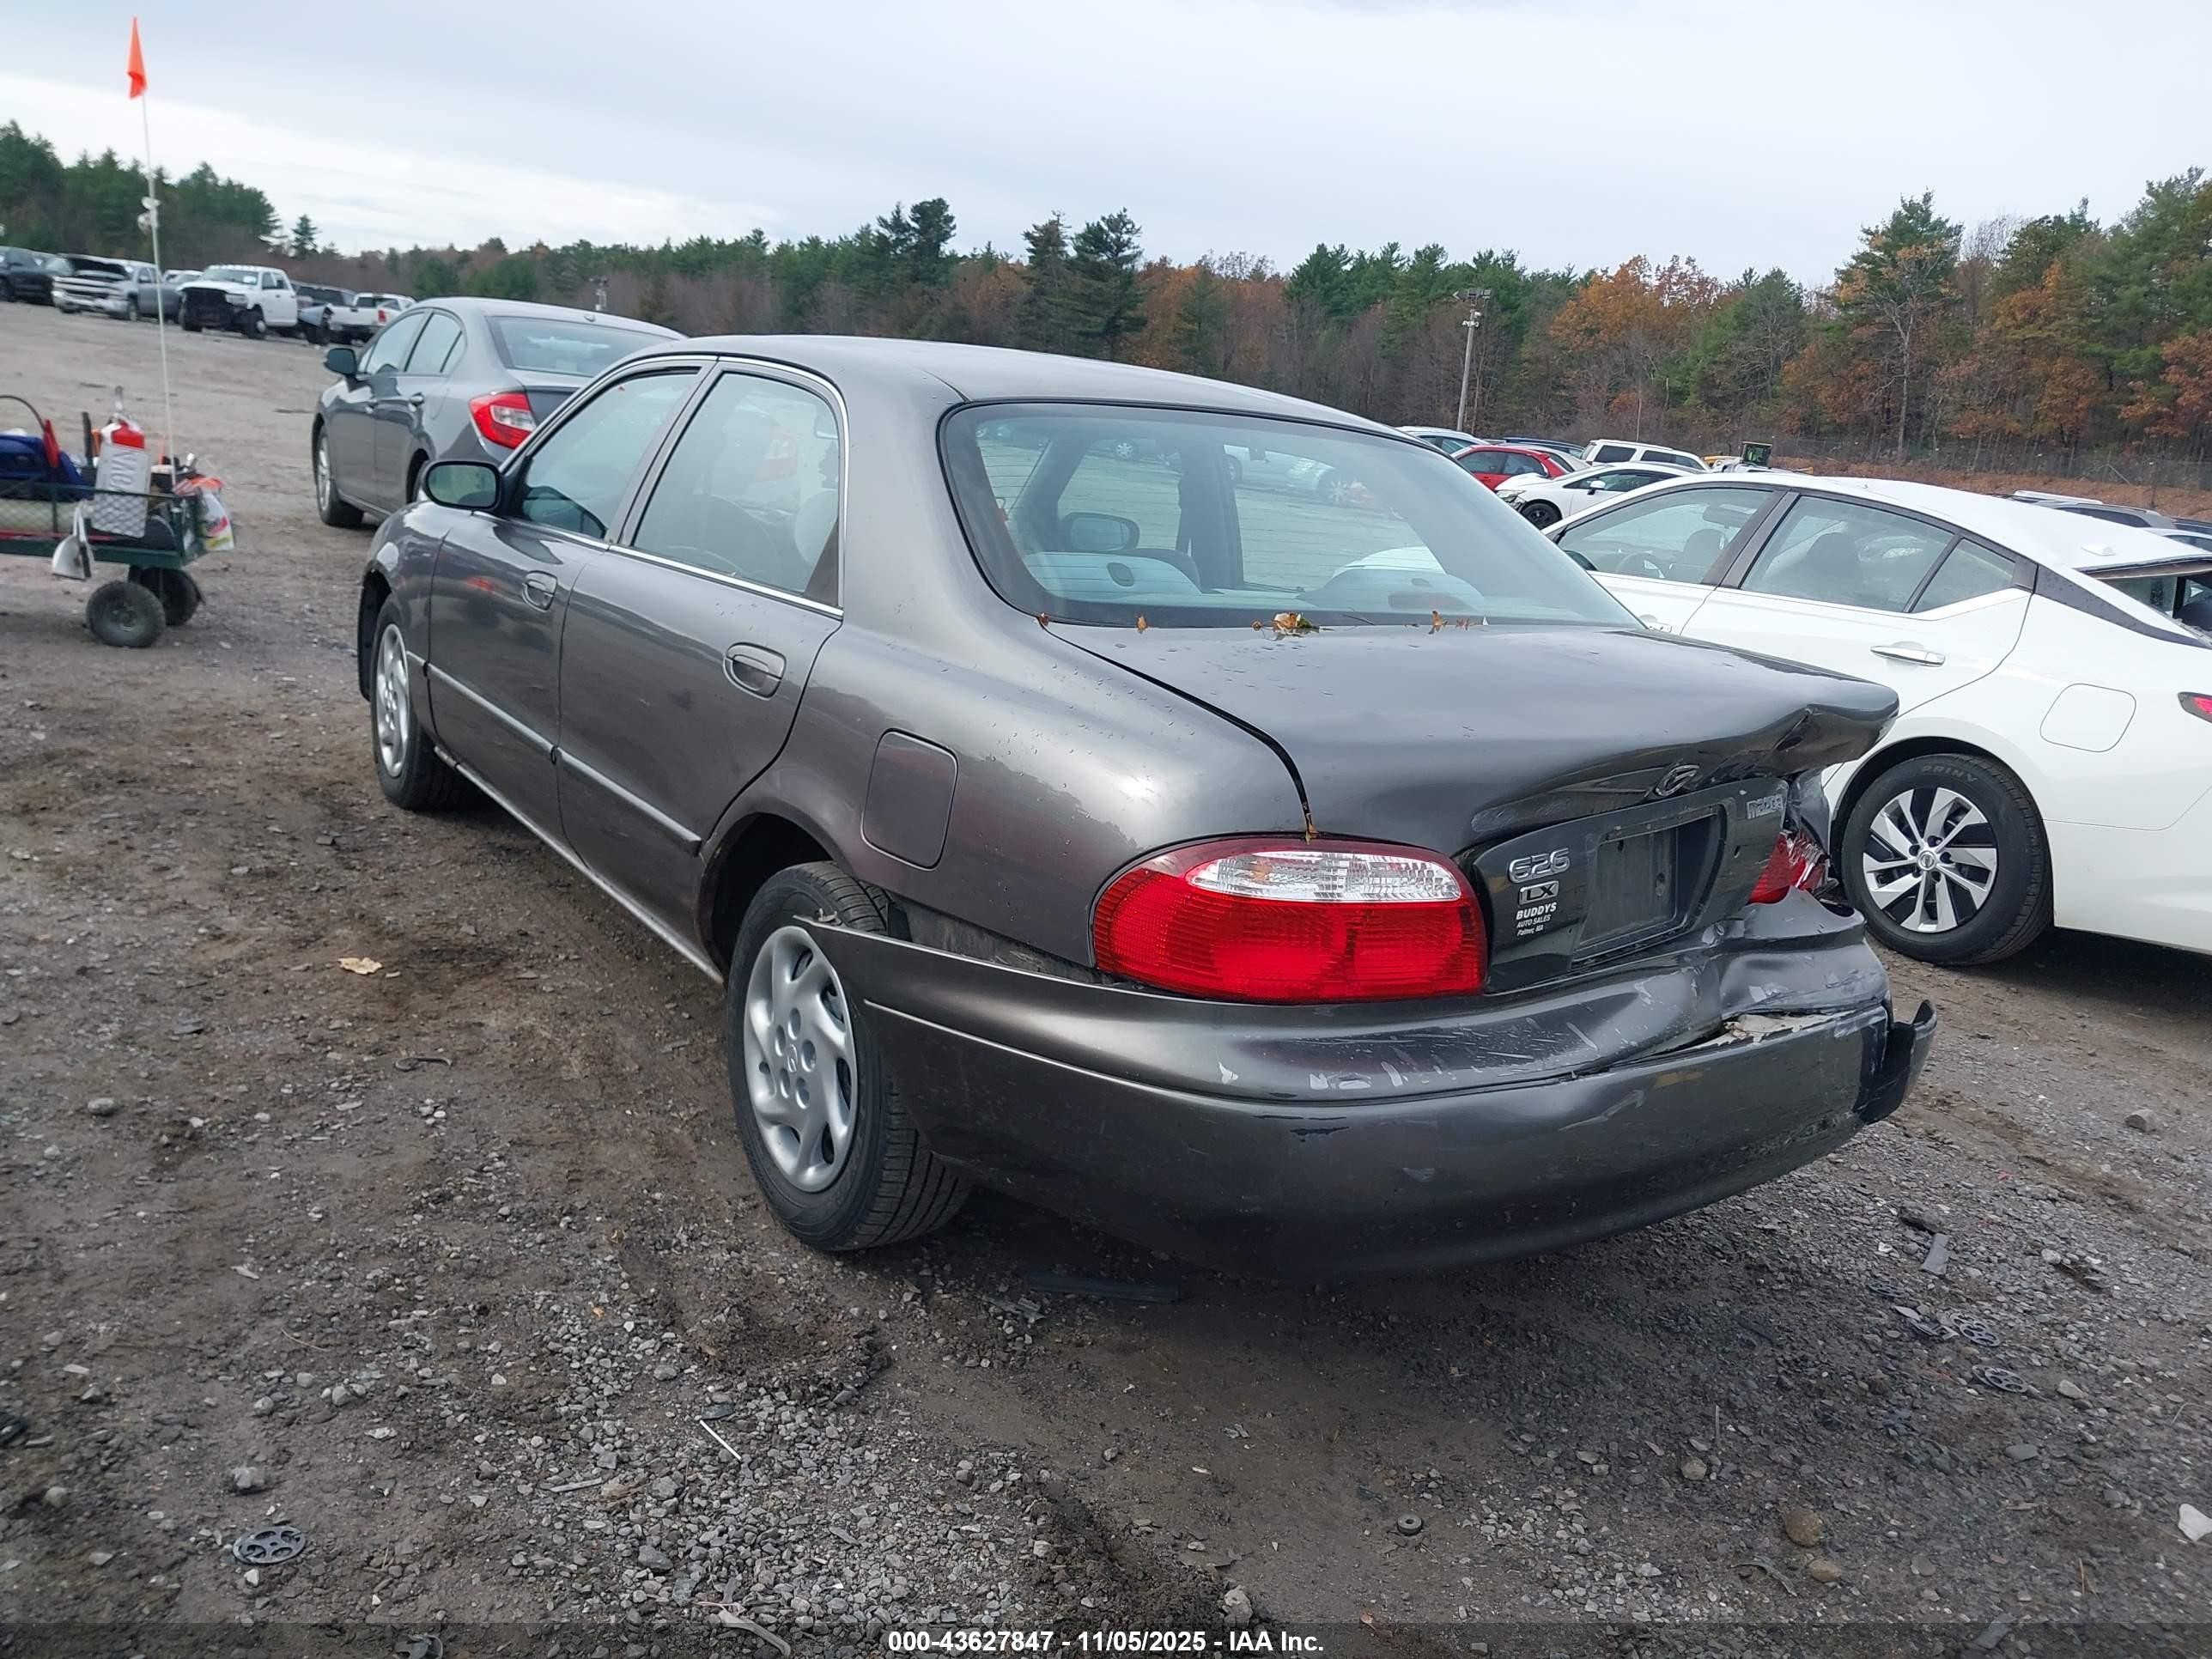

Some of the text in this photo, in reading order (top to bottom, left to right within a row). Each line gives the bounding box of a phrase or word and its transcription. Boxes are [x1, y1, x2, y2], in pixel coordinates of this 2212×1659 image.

[1509, 847, 1571, 884] 626
[1523, 882, 1558, 902] LX
[1516, 902, 1558, 921] BUDDYS
[1516, 914, 1552, 928] AUTO SALES
